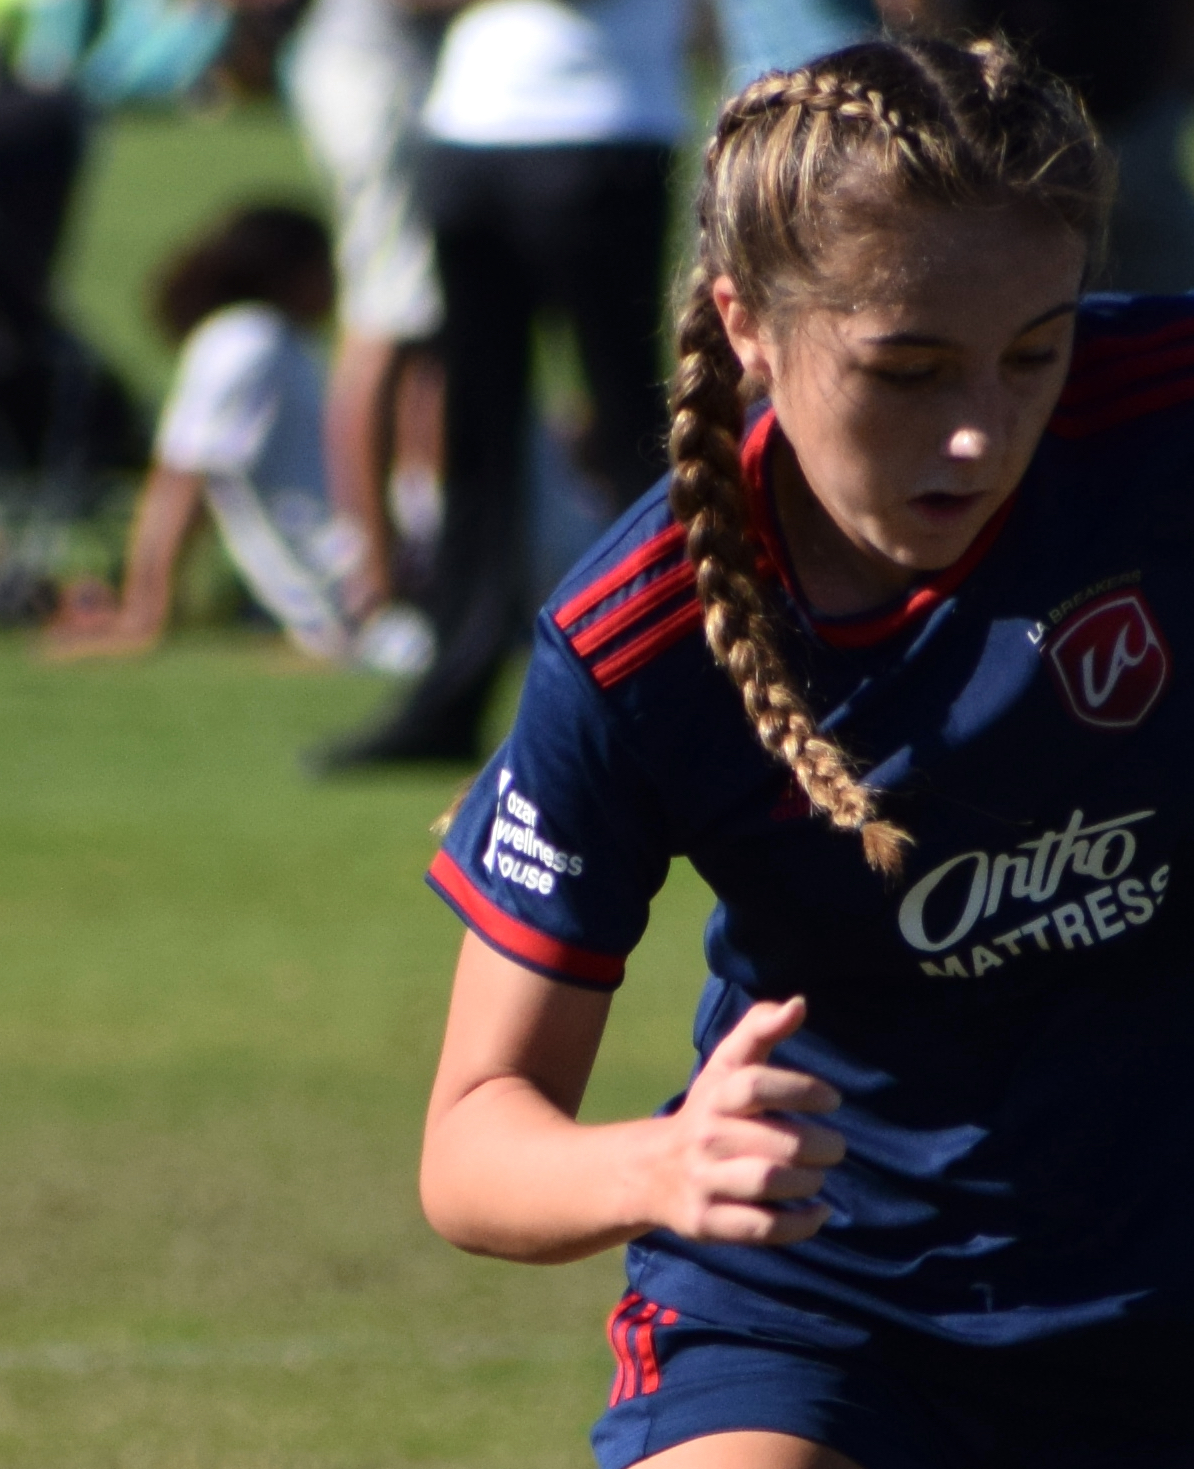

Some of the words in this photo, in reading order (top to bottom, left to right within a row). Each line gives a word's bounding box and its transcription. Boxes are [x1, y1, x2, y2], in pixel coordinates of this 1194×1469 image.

[497, 818, 583, 876] wellness
[497, 852, 554, 895] ouse
[898, 809, 1156, 951] Ortho
